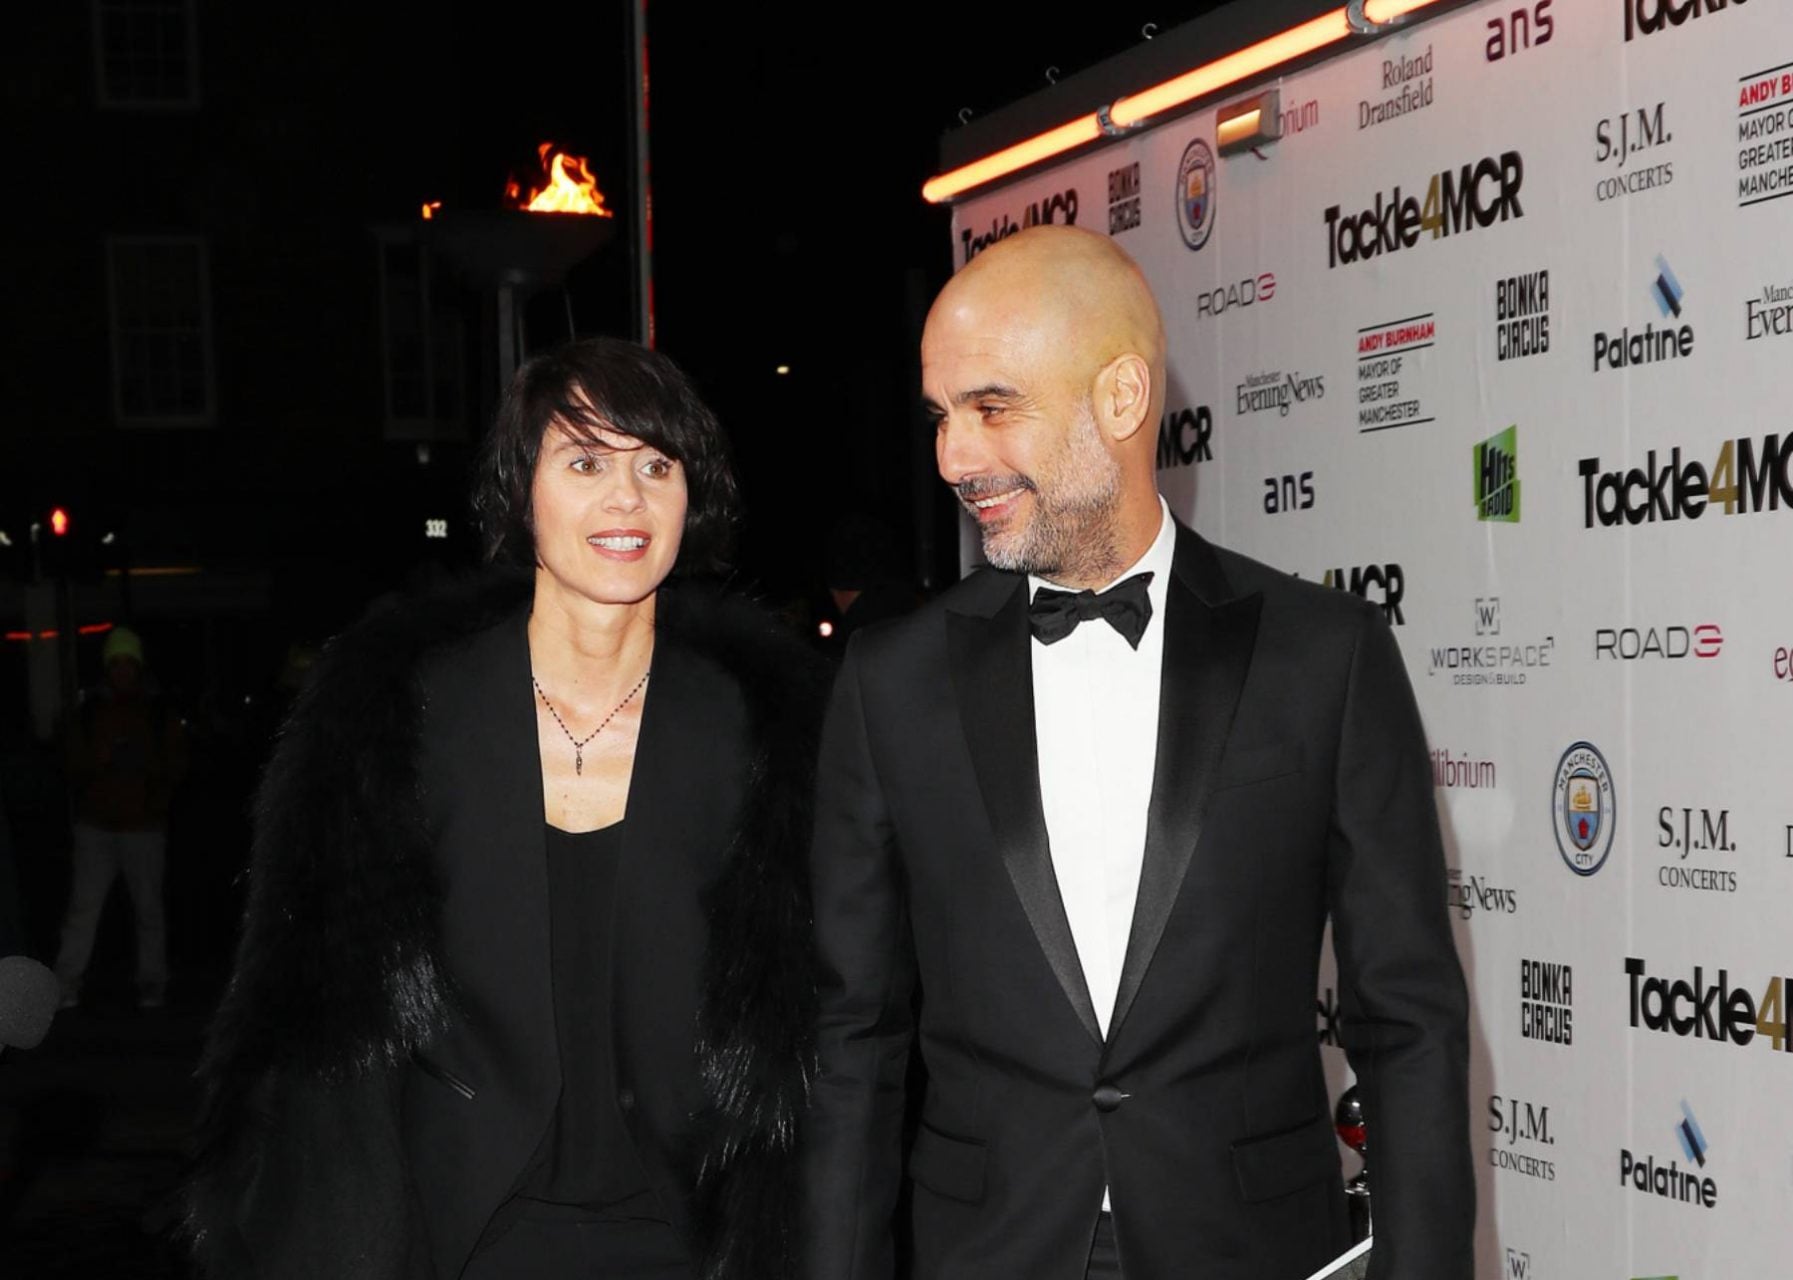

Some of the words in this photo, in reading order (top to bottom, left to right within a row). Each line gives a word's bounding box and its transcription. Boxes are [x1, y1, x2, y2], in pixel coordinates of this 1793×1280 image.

[1486, 0, 1554, 62] ans
[1382, 44, 1433, 90] Roland
[1358, 77, 1433, 131] Dransfield
[1739, 78, 1777, 108] ANDY
[1597, 101, 1672, 167] S.J.M.
[1739, 111, 1785, 142] MAYOR
[1739, 137, 1793, 170] GREATE
[1597, 162, 1673, 201] CONCERTS
[1324, 150, 1524, 269] Tackle4MCR
[1497, 270, 1549, 321] BONKA
[1358, 333, 1383, 353] ANDY
[1386, 321, 1435, 348] BURNHAM
[1497, 314, 1550, 361] CIRCUS
[1594, 322, 1694, 372] Palatine
[1359, 360, 1390, 380] MAYOR
[1391, 356, 1403, 375] OF
[1359, 381, 1400, 403] GREATER
[1359, 400, 1420, 424] MANCHESTER
[1263, 471, 1315, 514] ans
[1431, 645, 1551, 669] WORKSPACE
[1431, 748, 1496, 789] ilibrium
[1558, 752, 1609, 793] MANCHESTER
[1658, 806, 1737, 860] S.J.M.
[1575, 853, 1593, 866] CITY
[1659, 865, 1737, 893] CONCERTS
[1522, 958, 1572, 1006] BONKA
[1522, 1002, 1572, 1046] CIRCUS
[1489, 1095, 1555, 1146] S.J.M.
[1490, 1148, 1556, 1182] CONCERTS
[1621, 1149, 1718, 1209] Palatine
